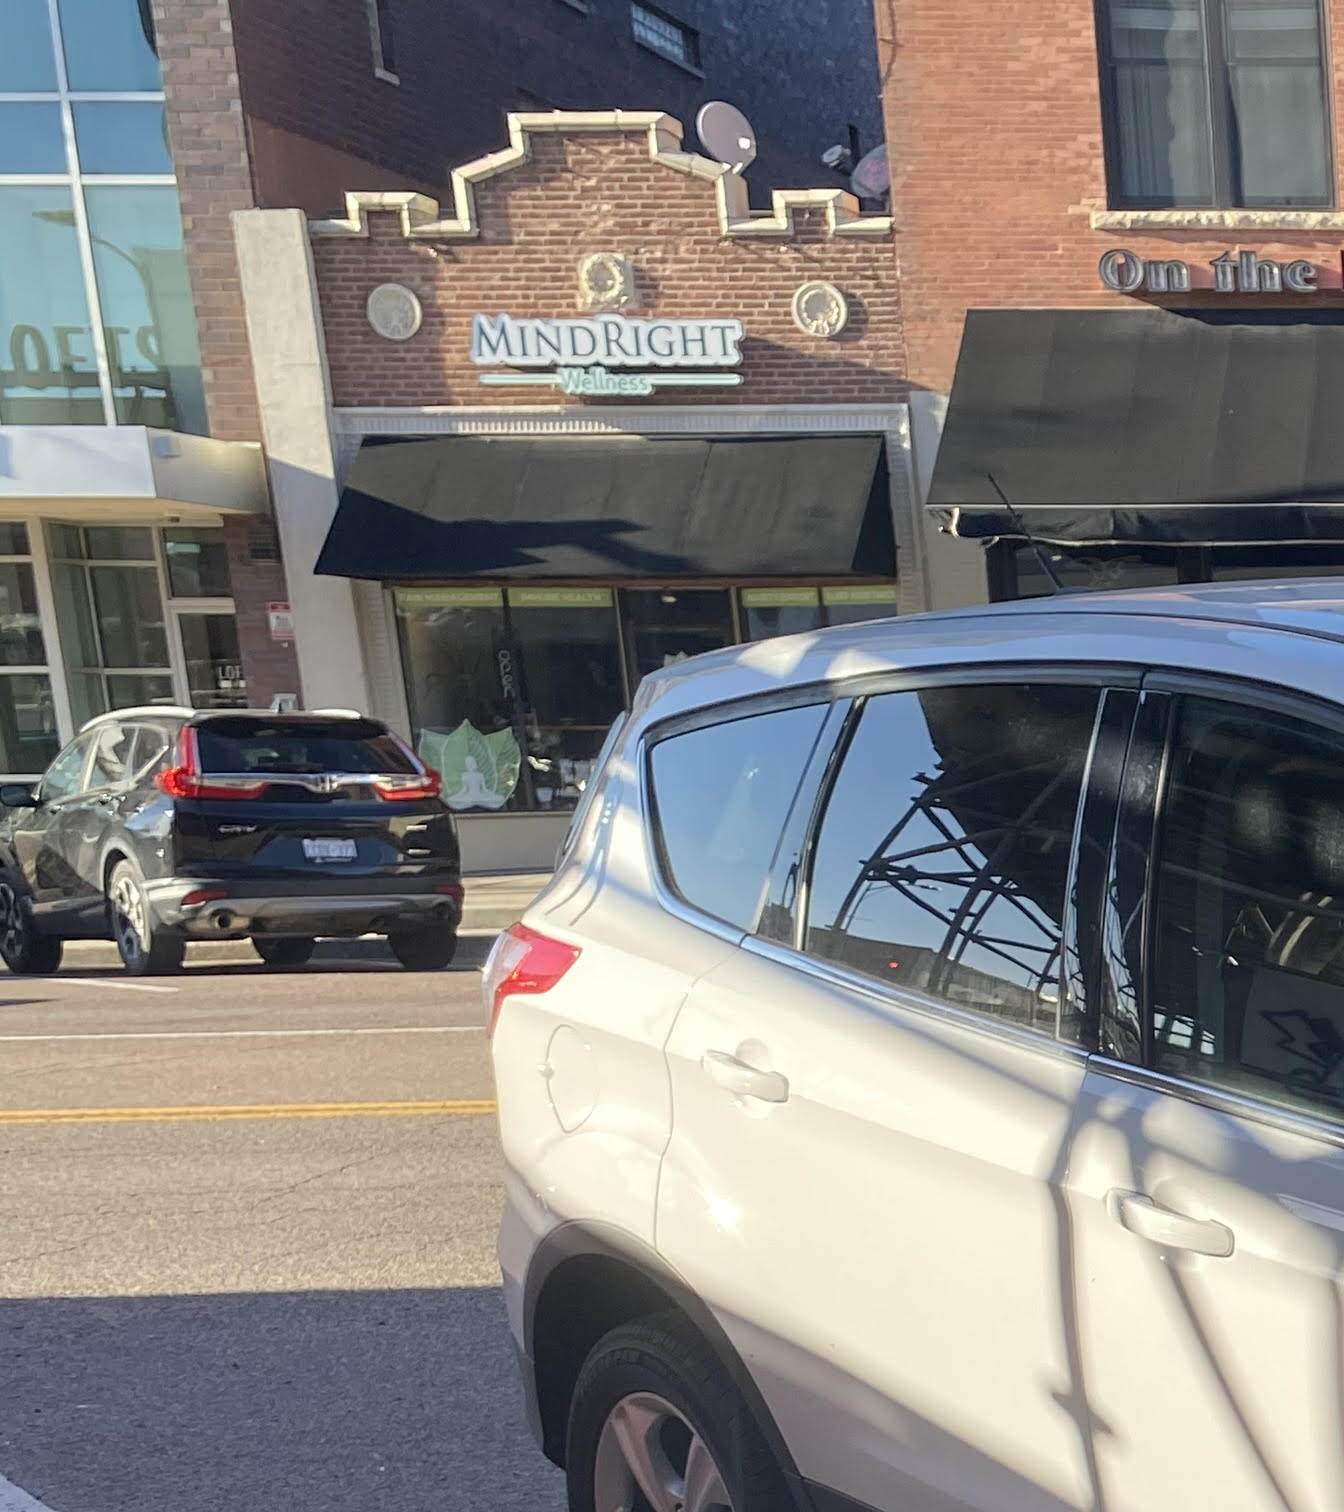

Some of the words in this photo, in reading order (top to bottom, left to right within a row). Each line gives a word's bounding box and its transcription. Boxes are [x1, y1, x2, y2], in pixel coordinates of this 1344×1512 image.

[1098, 247, 1193, 294] On
[1210, 249, 1319, 294] the
[560, 369, 650, 393] Wellness
